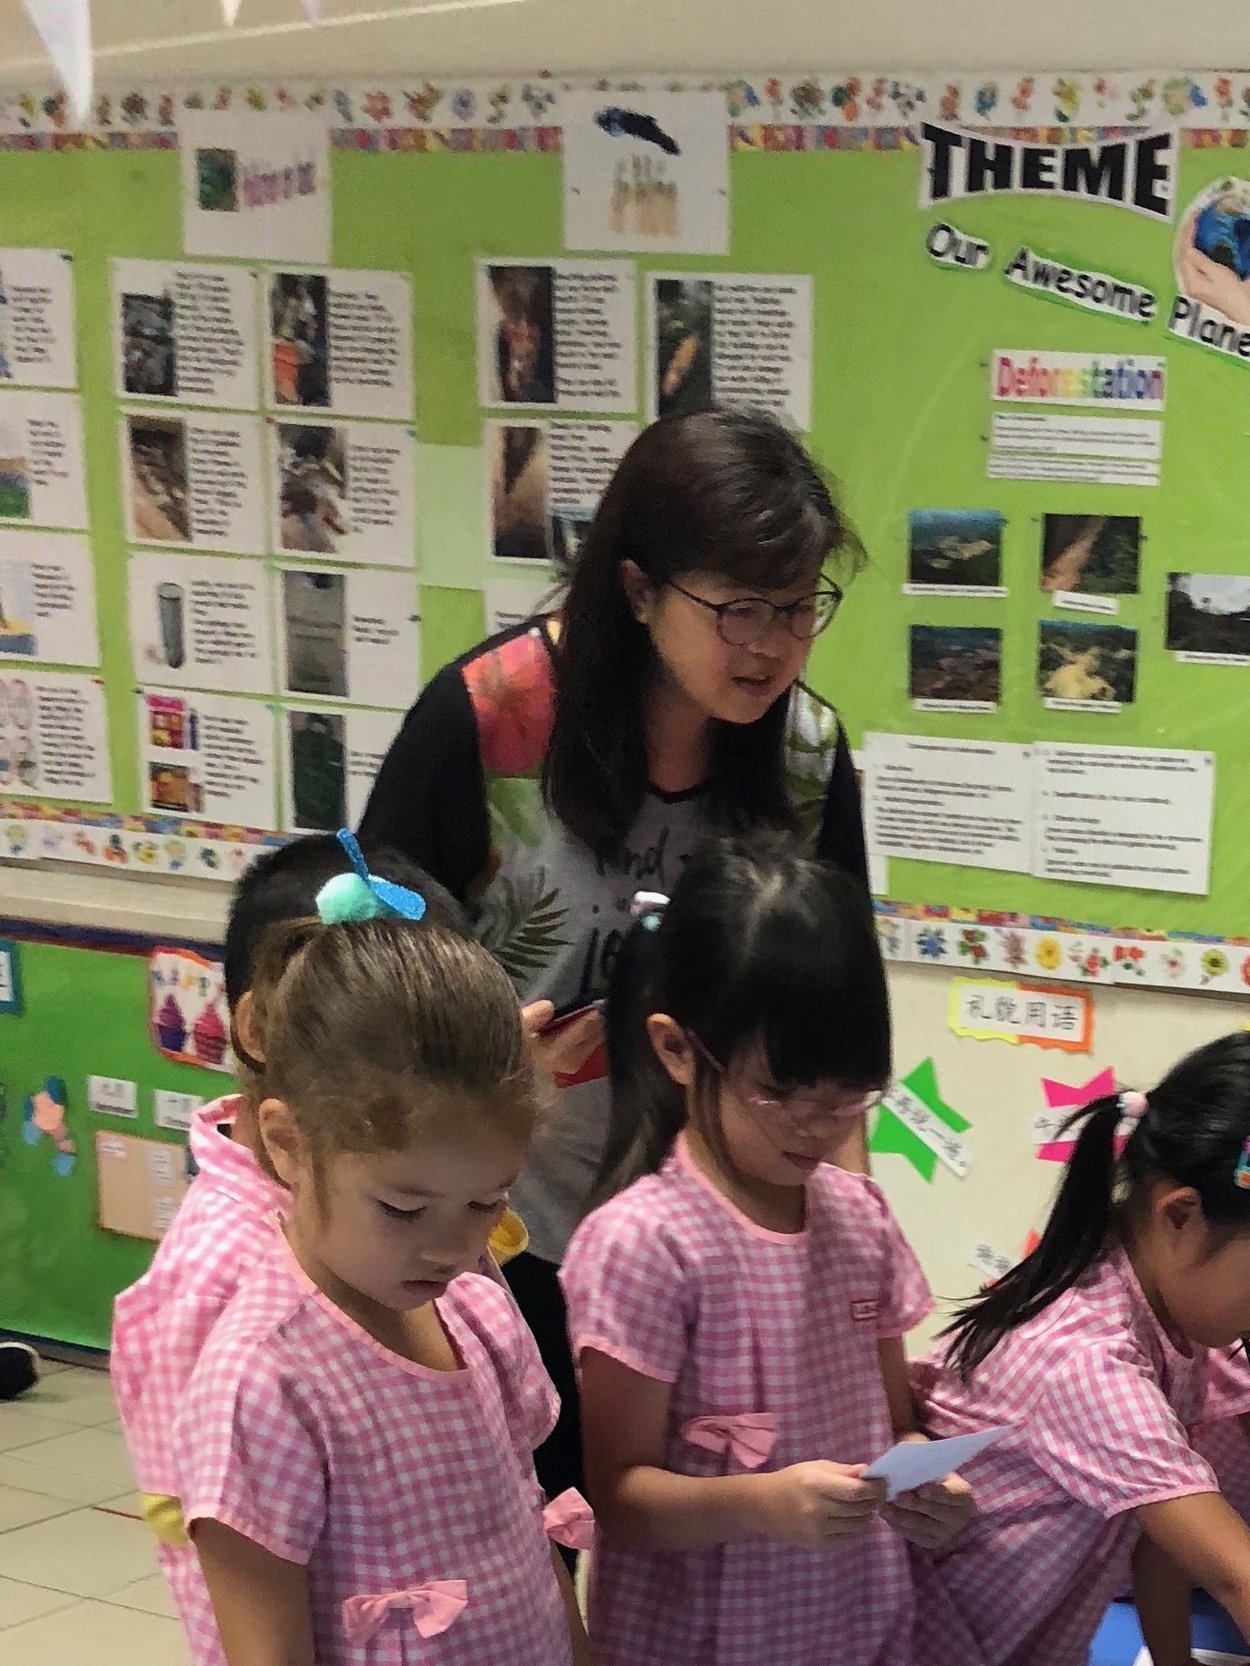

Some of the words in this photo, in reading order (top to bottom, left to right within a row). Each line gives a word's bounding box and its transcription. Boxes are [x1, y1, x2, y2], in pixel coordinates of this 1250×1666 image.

[921, 121, 1172, 217] THEME
[926, 222, 989, 266] Our
[1003, 247, 1155, 318] Awesome
